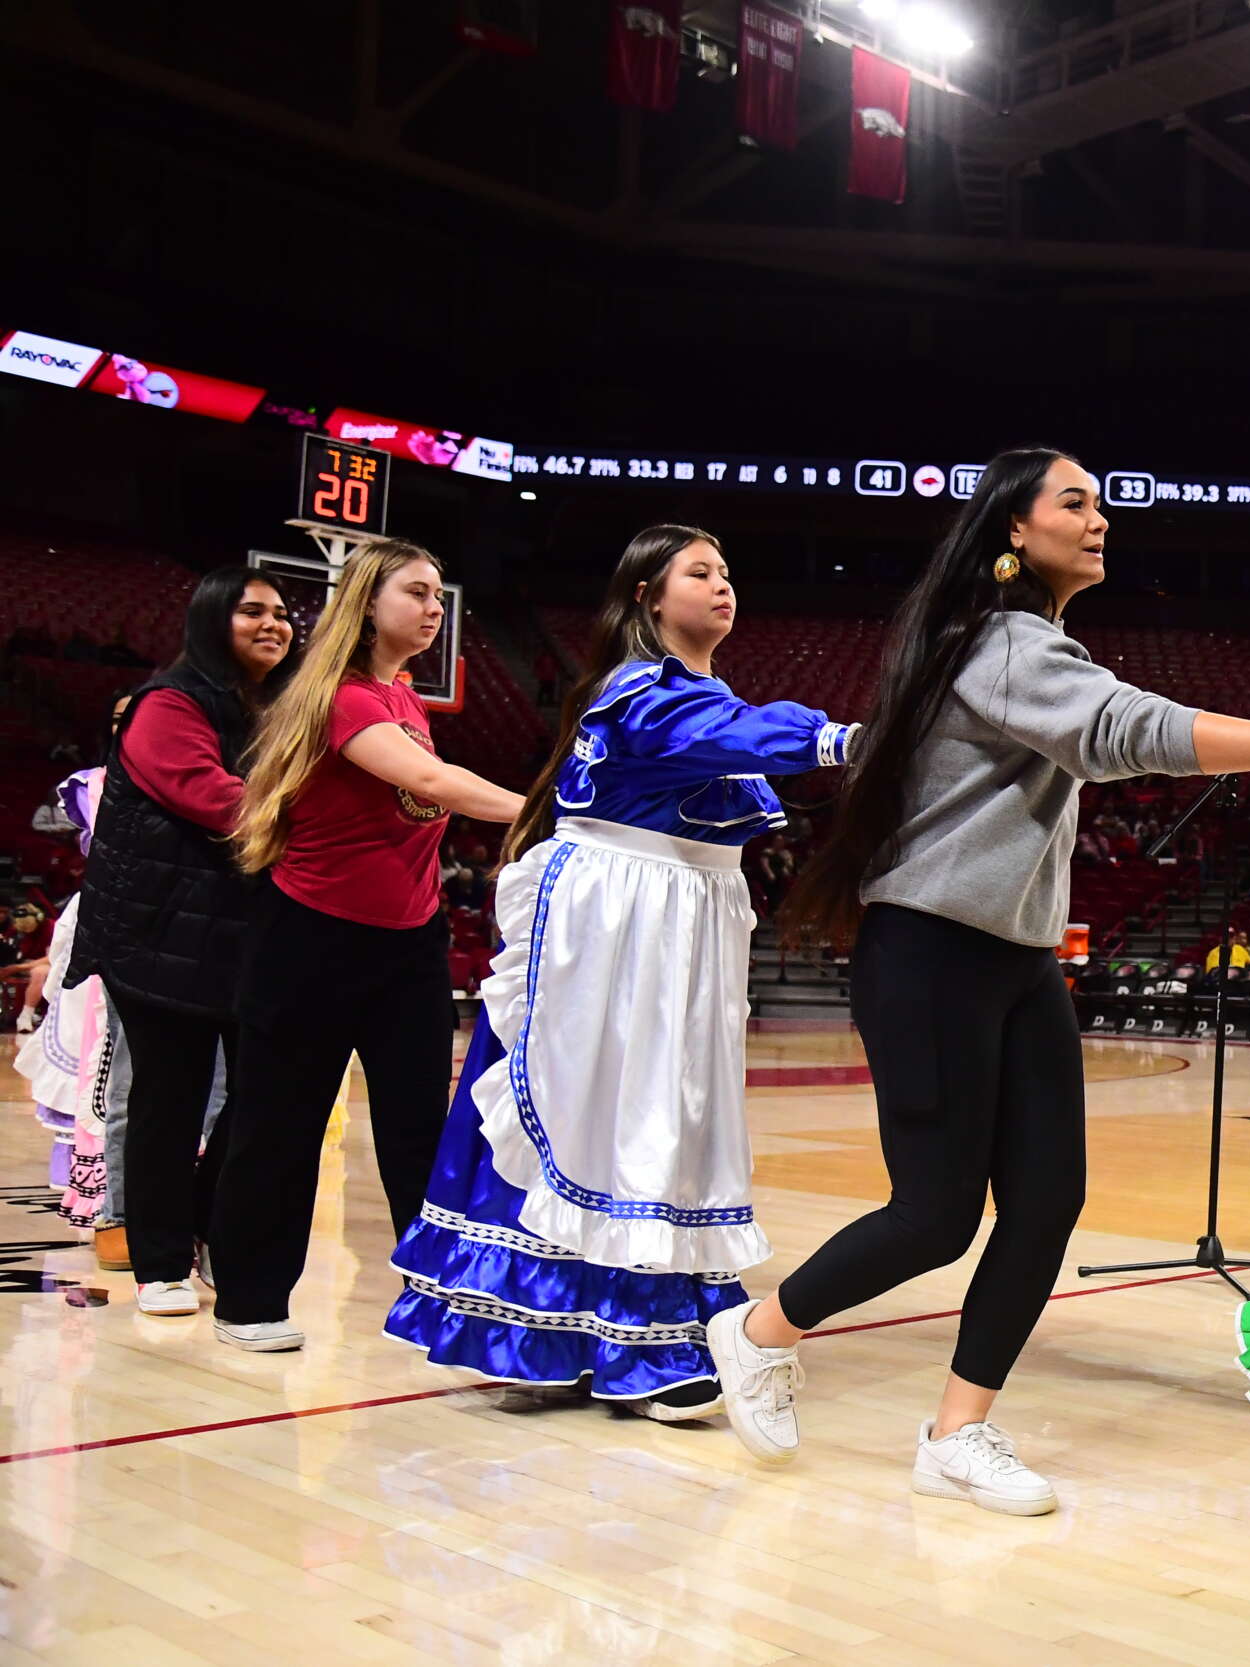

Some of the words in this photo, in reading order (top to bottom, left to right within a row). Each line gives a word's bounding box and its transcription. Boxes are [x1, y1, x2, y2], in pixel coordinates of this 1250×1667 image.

[10, 346, 82, 373] RAYOVAC
[543, 456, 585, 475] 46.7
[628, 459, 668, 478] 33.3
[707, 462, 727, 480] 17
[774, 465, 787, 483] 6
[827, 467, 841, 486] 8
[869, 469, 893, 489] 41
[313, 472, 369, 524] 20
[1120, 479, 1145, 499] 33
[1182, 484, 1219, 502] 39.3
